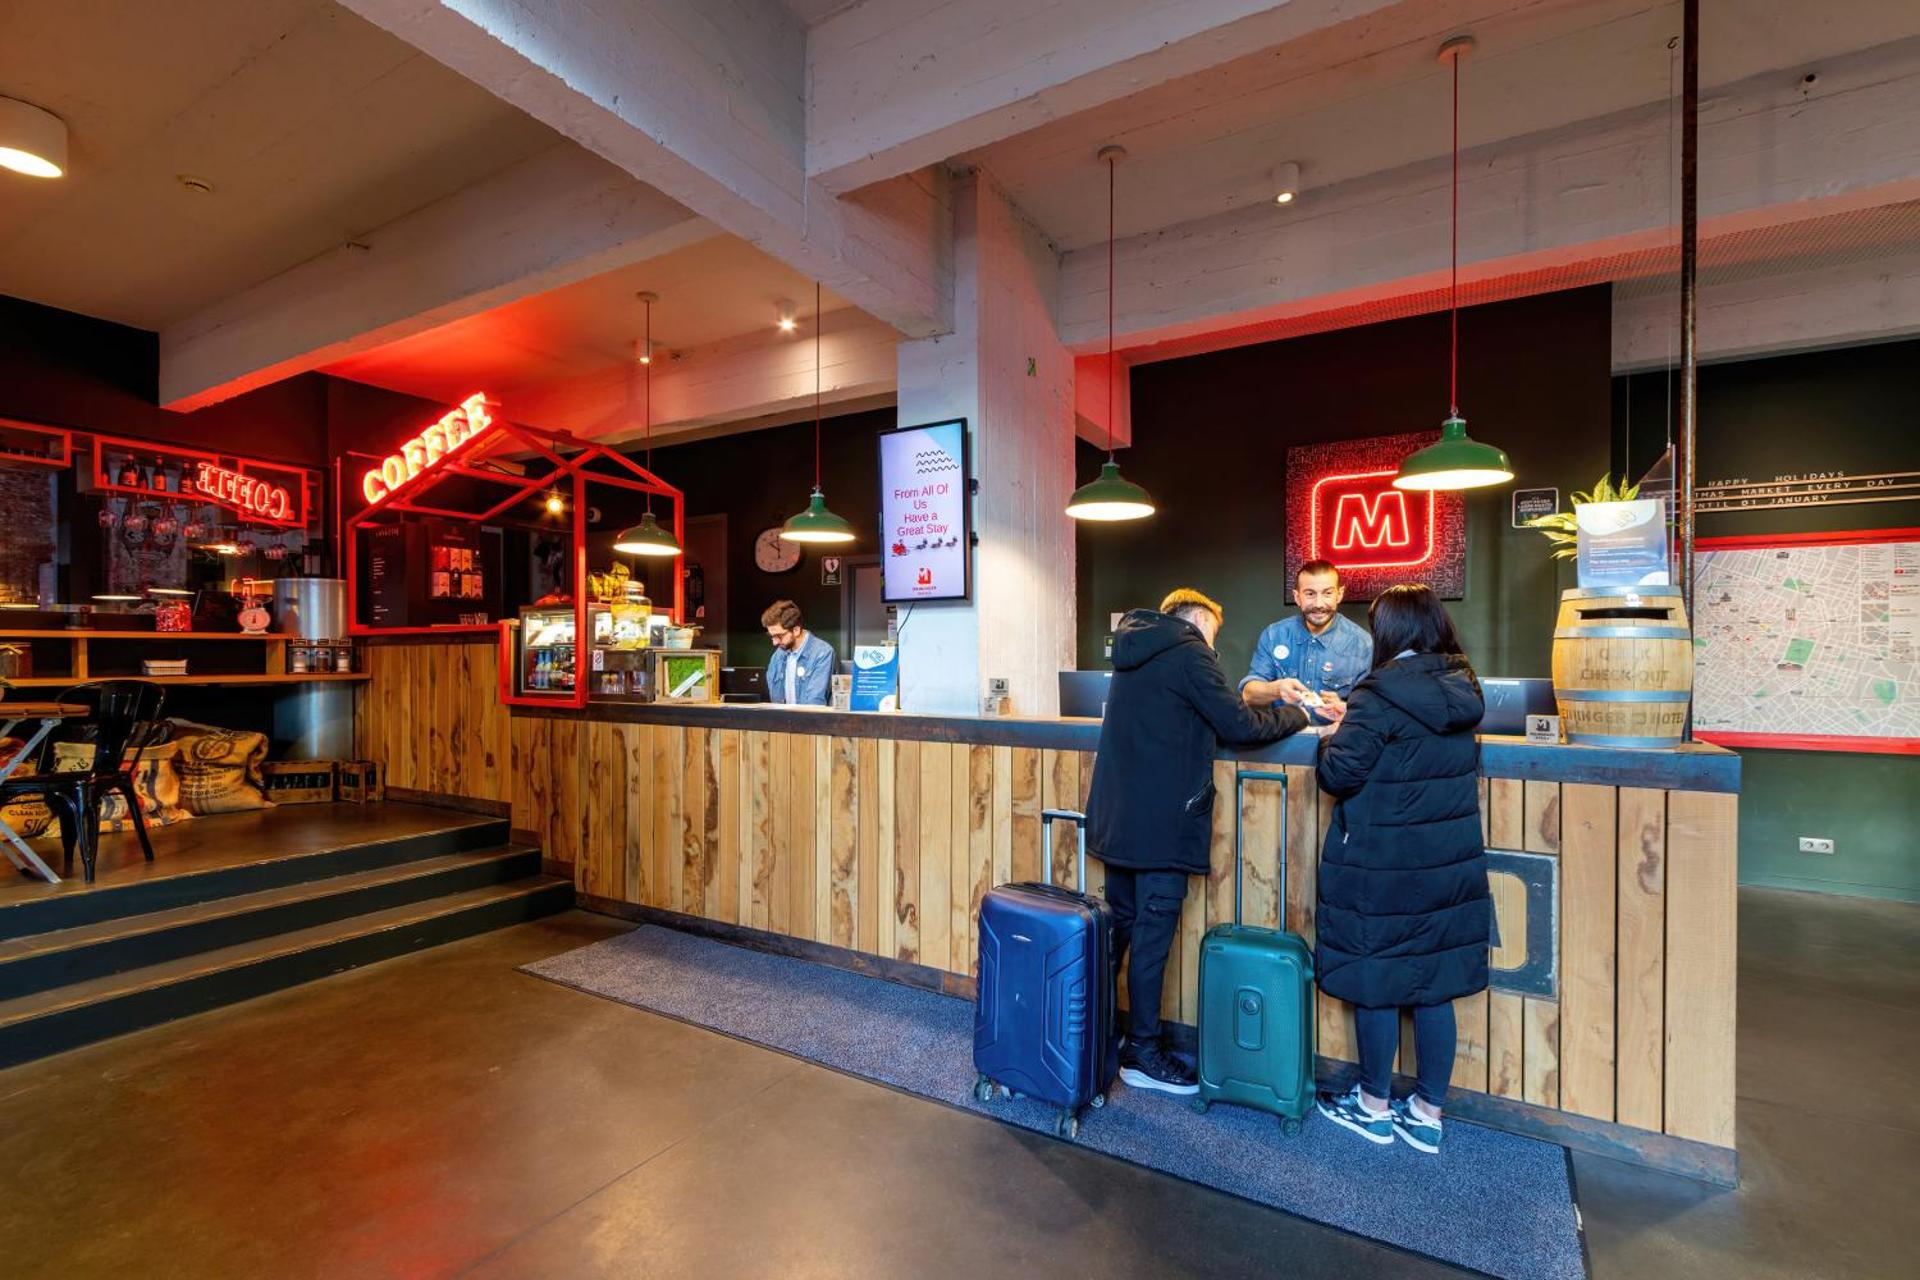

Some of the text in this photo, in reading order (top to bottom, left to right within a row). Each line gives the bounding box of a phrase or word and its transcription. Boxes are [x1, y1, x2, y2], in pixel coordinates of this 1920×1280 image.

[363, 391, 492, 505] COFFEE
[1707, 470, 1845, 487] HAPPY HOLIDAYS
[894, 482, 949, 501] From All Of
[1694, 478, 1895, 499] TMAS MARKET EVERY DAY
[913, 499, 928, 511] Us
[1770, 494, 1829, 505] JANUARY
[904, 511, 938, 525] Have a
[1333, 492, 1409, 549] M
[896, 522, 949, 538] Great Stay
[1580, 668, 1671, 682] CHECK-OUT
[1649, 710, 1684, 725] HOTE
